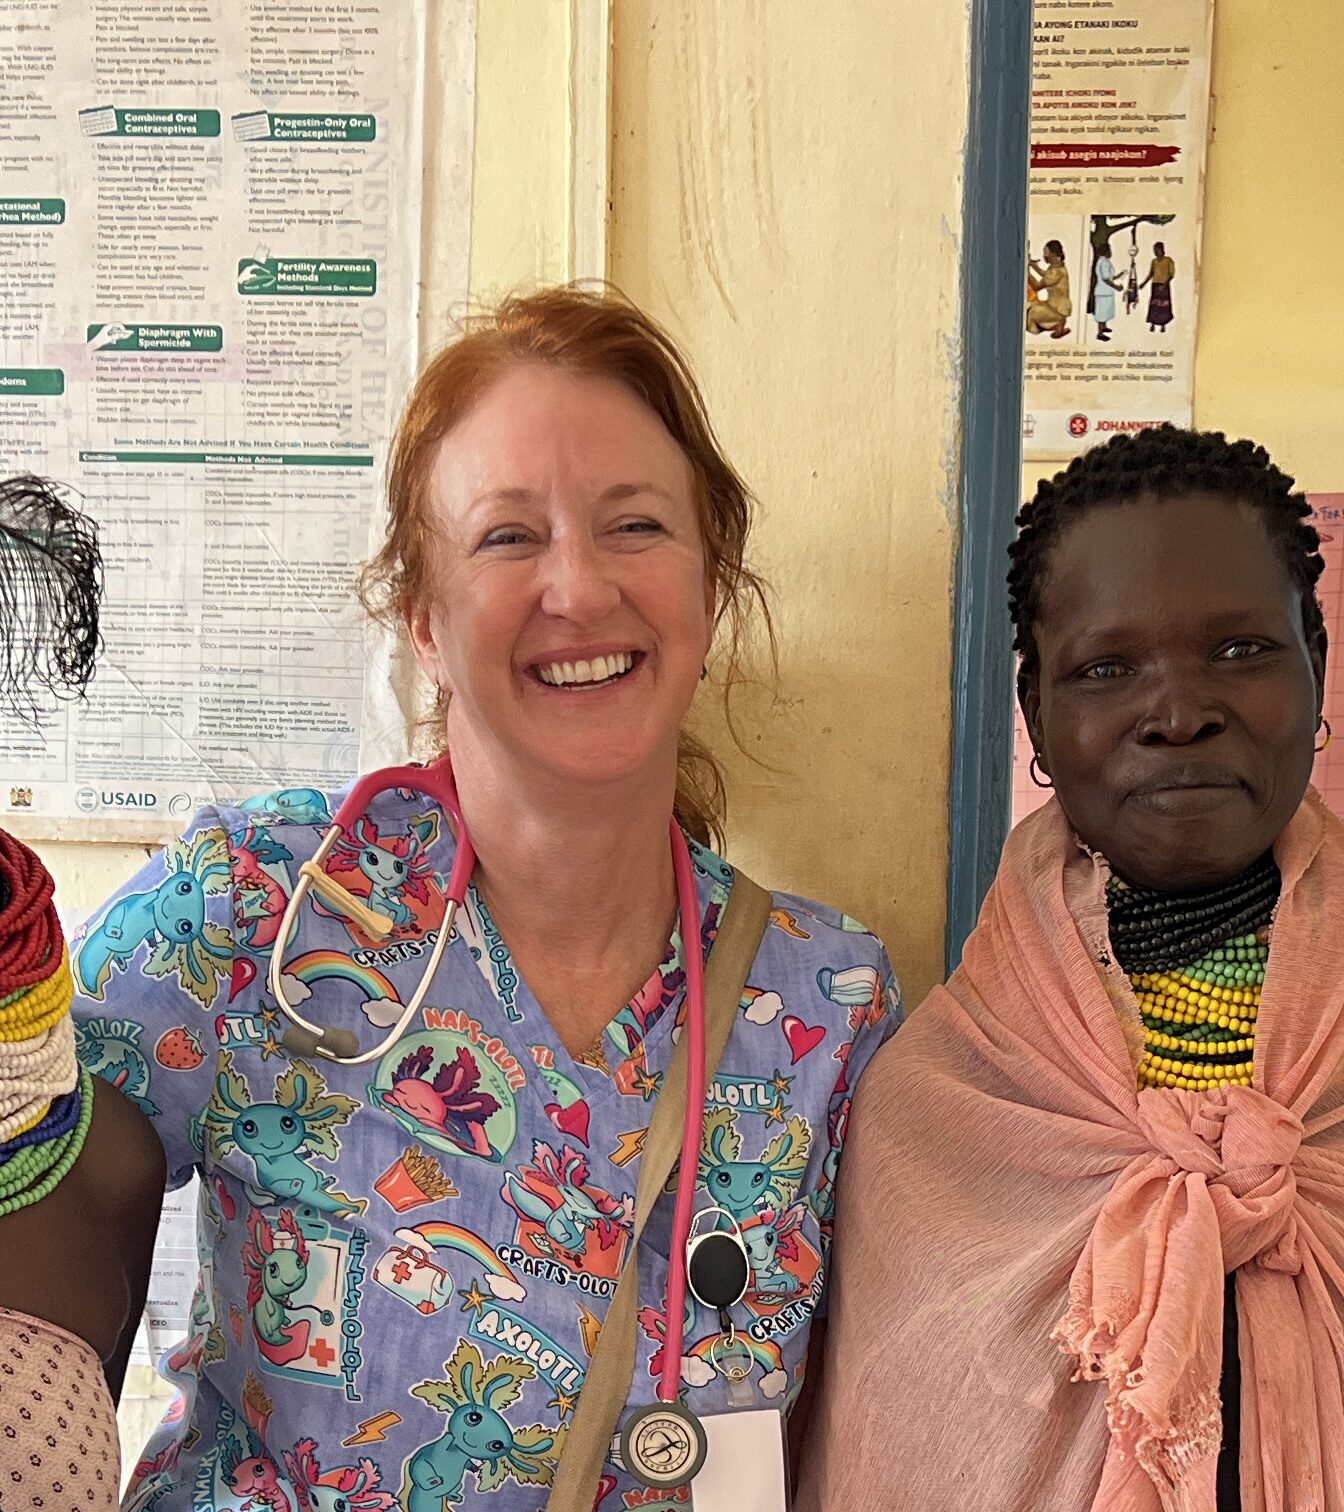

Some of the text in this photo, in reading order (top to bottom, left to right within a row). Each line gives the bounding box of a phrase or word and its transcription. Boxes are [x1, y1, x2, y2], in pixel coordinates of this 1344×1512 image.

[124, 113, 197, 122] Combined Oral
[274, 118, 371, 128] Progestin-Only Oral
[124, 124, 197, 134] Contraceptives
[274, 129, 347, 140] Contraceptives
[22, 213, 62, 222] Method)
[277, 262, 371, 273] Fertility Awareness
[277, 273, 319, 282] Methods
[138, 328, 217, 338] Diaphragm With
[138, 339, 191, 348] Spermicide
[101, 792, 157, 806] USAID
[423, 1007, 527, 1091] NAPS-OLOTL
[496, 1245, 621, 1298] CRAFTS-OLOT
[476, 1310, 584, 1393] AXOLOTL
